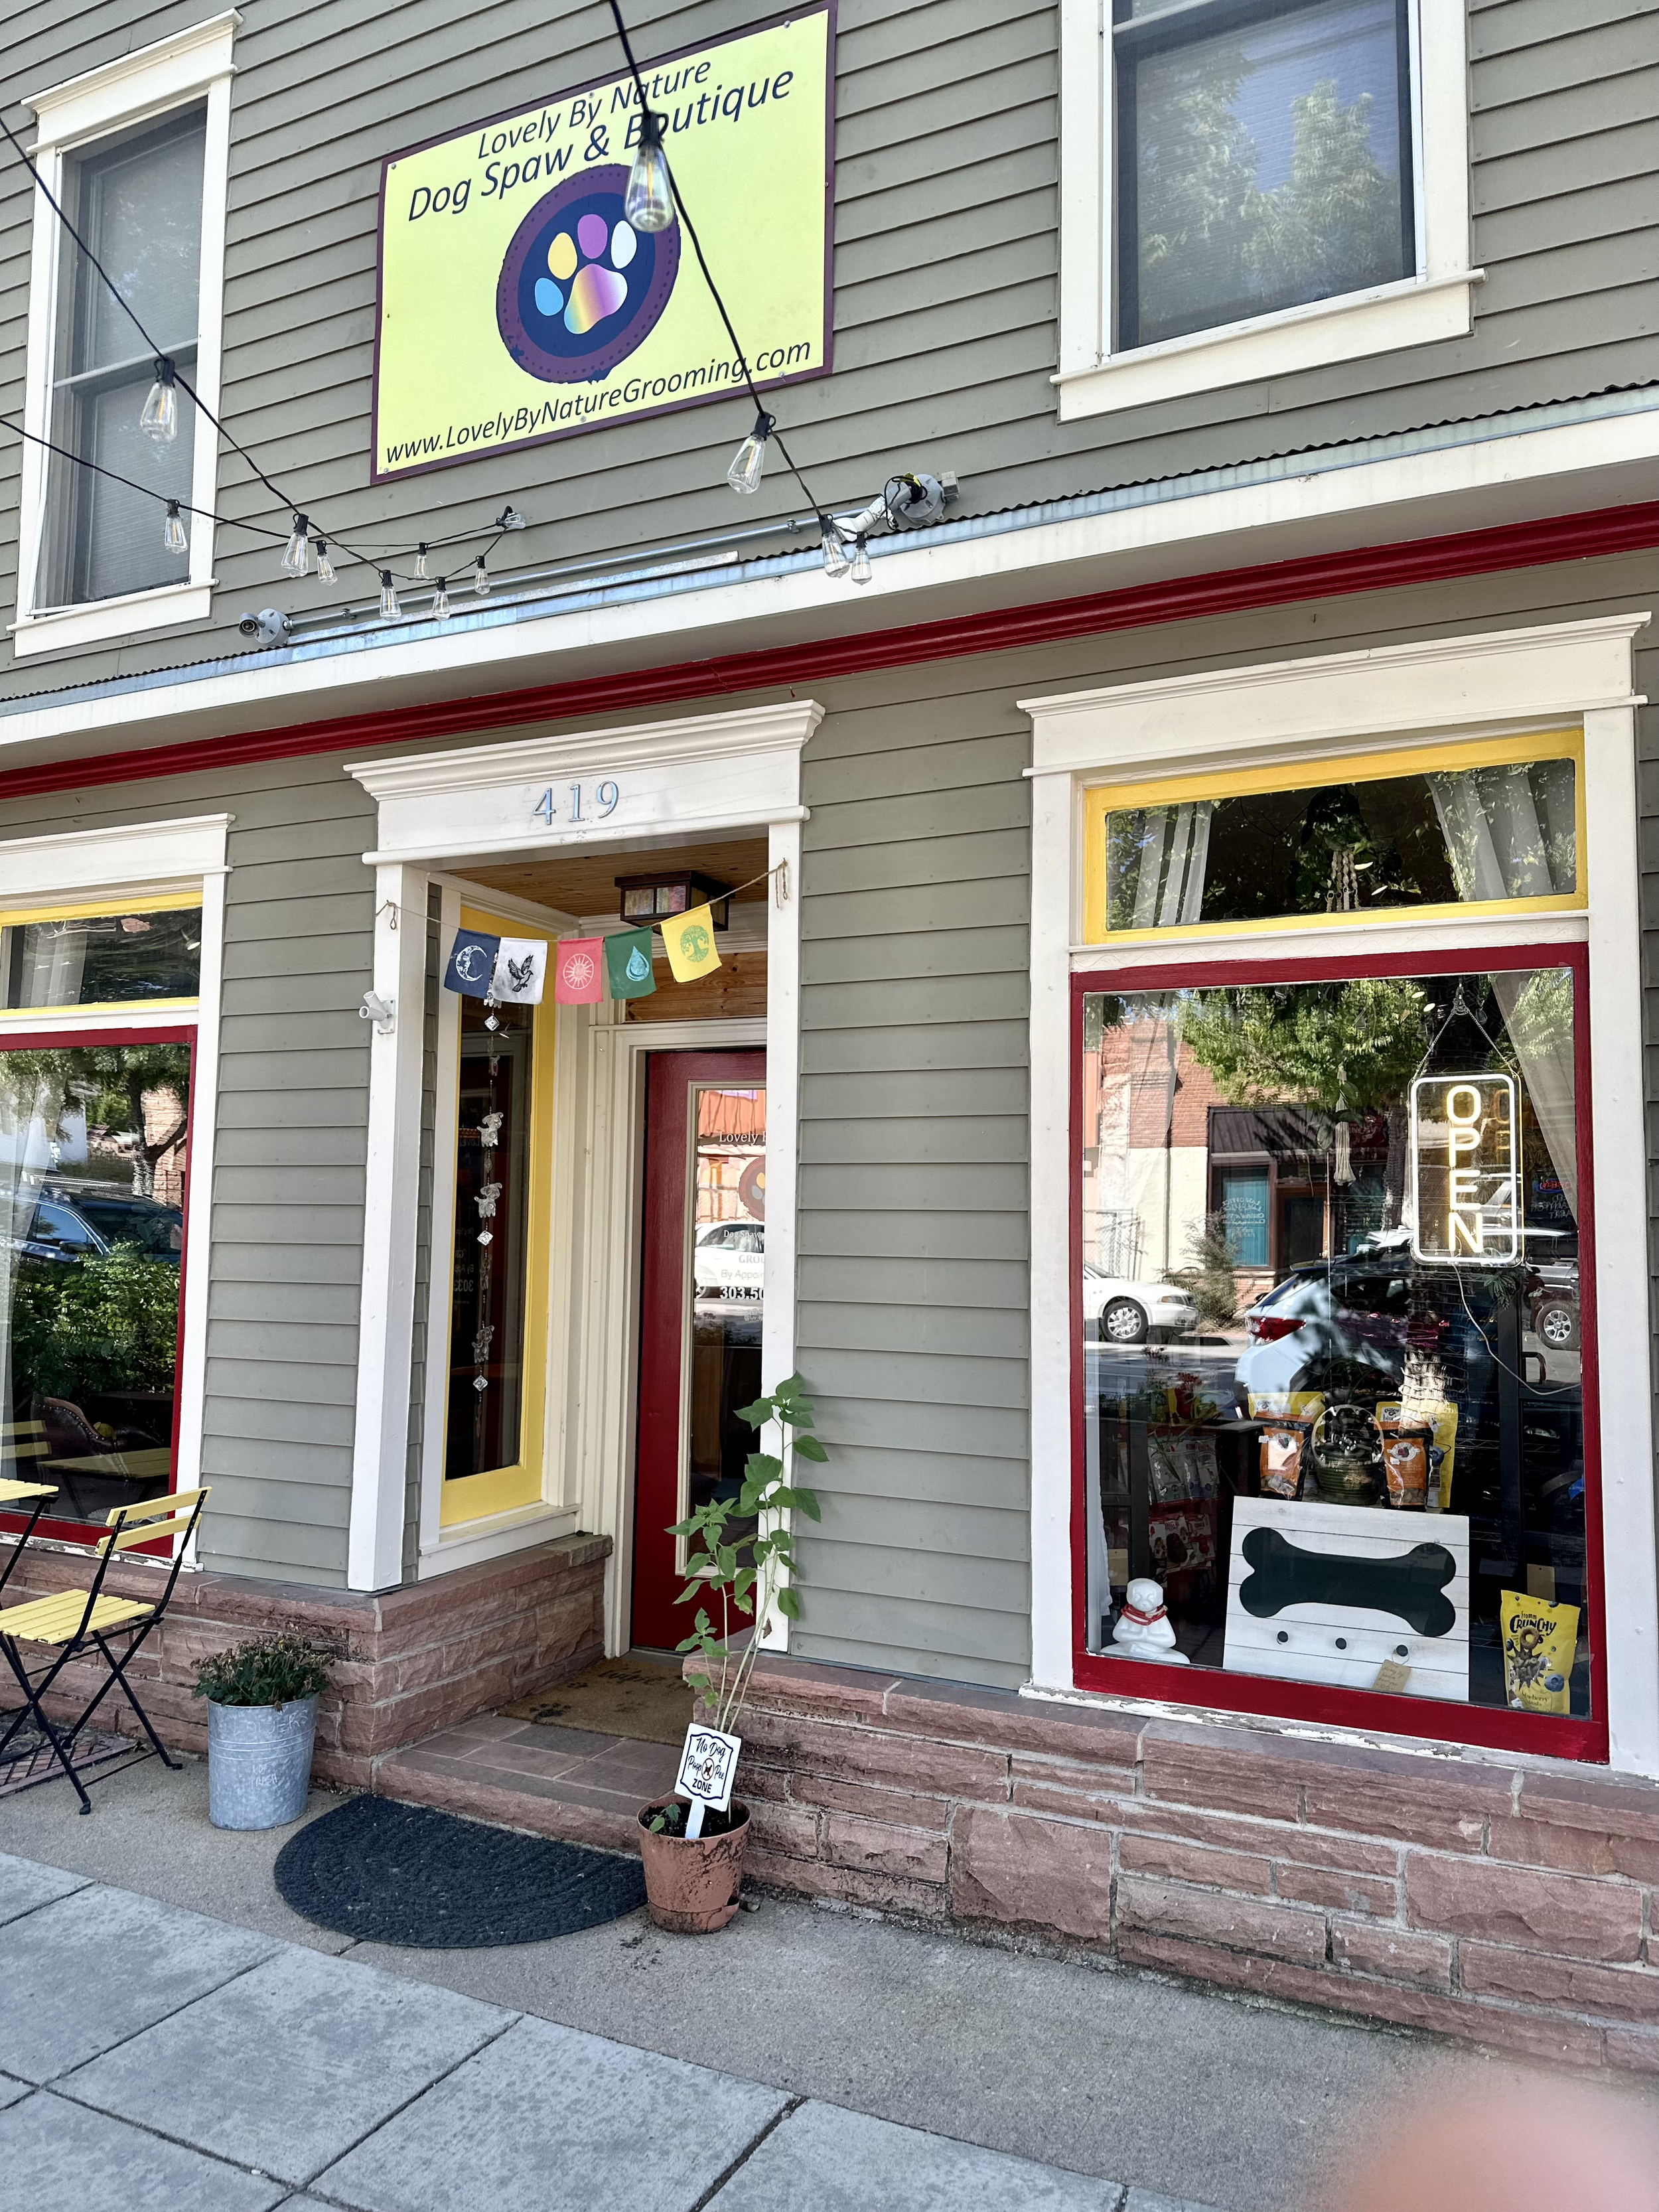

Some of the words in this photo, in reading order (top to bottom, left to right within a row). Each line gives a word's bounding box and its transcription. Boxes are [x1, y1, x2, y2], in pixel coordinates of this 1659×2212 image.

[478, 110, 560, 159] Lovely
[570, 99, 601, 129] By
[611, 61, 711, 113] Nature
[408, 180, 472, 221] Dog
[481, 141, 573, 198] Spaw
[583, 125, 610, 161] &
[624, 70, 794, 149] Butique
[386, 340, 810, 463] www.LovelyByNatureGrooming.com
[533, 780, 619, 825] 419
[719, 1131, 758, 1145] Lovely
[1446, 1084, 1484, 1254] OPEN
[721, 1269, 733, 1280] By
[687, 1755, 702, 1777] Poop
[714, 1765, 725, 1780] Pee
[696, 1737, 707, 1754] No
[709, 1742, 726, 1763] Dog
[692, 1778, 712, 1794] ZONE
